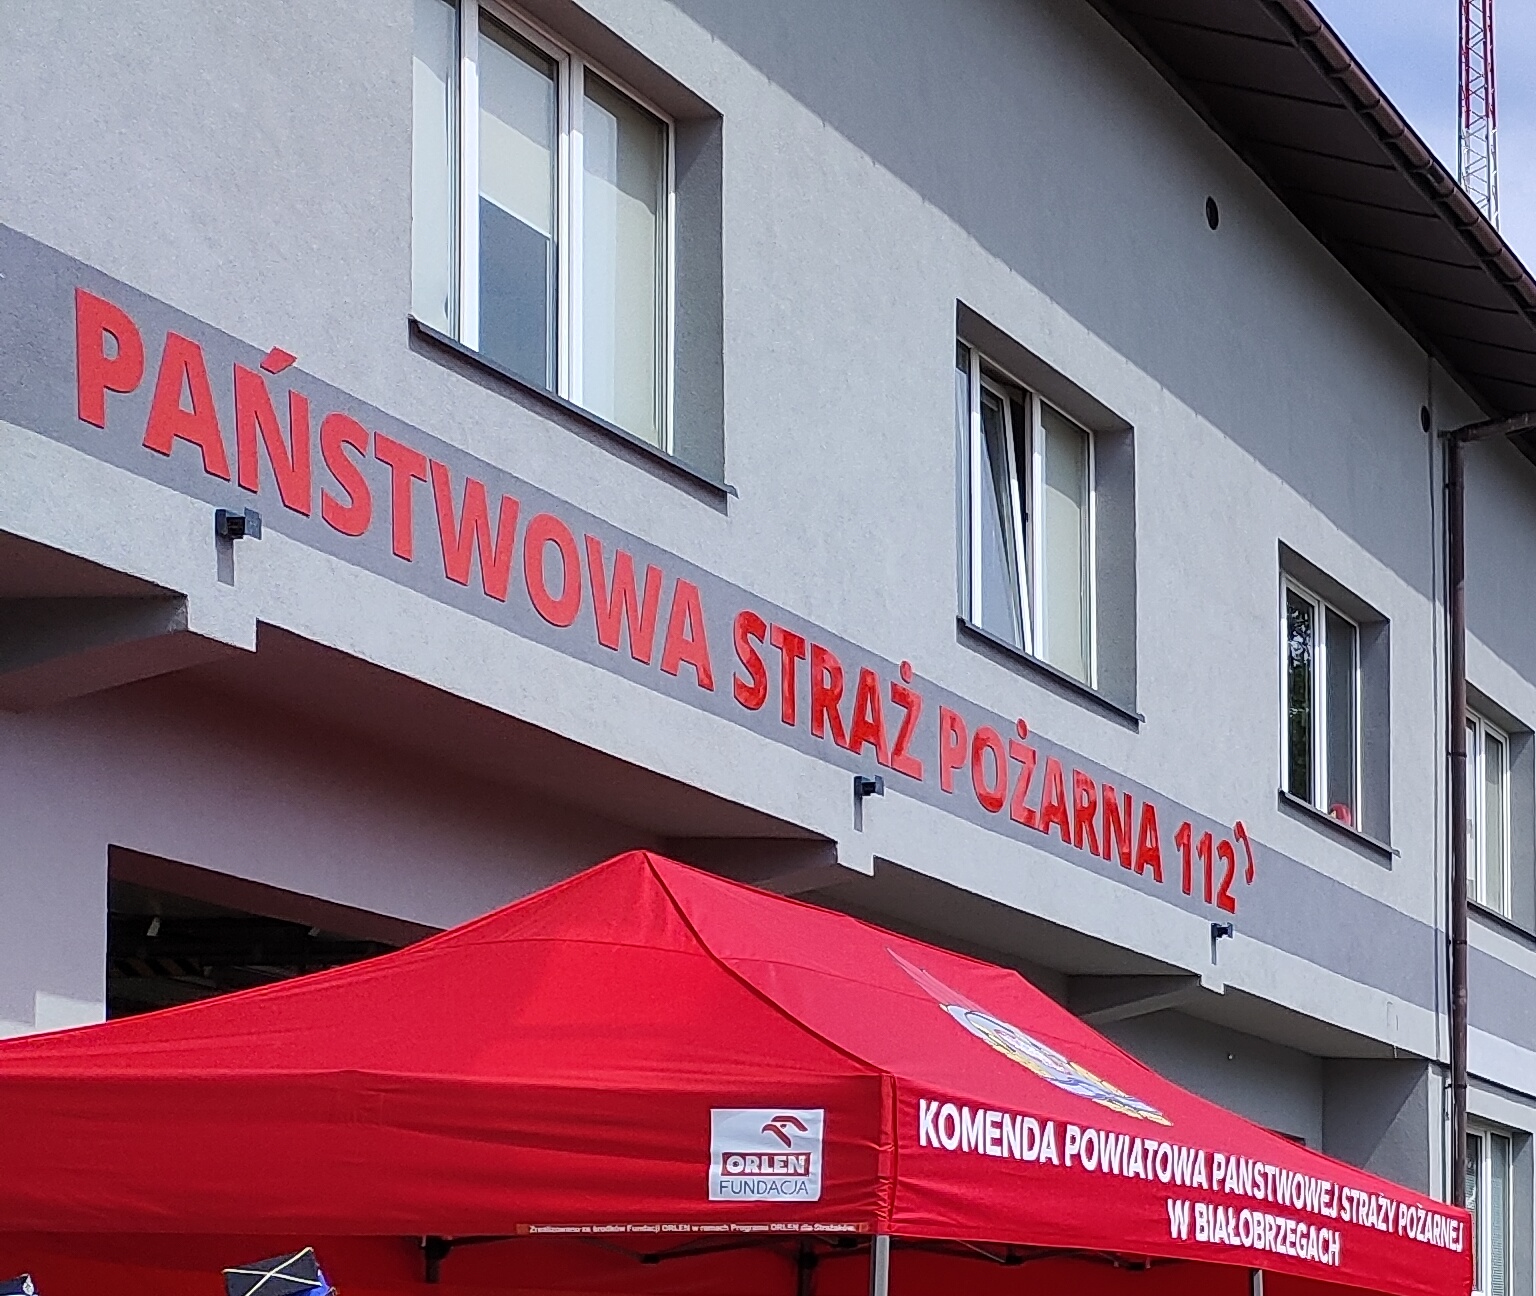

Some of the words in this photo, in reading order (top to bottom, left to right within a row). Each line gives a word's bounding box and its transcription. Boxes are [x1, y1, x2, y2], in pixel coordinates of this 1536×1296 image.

[75, 286, 714, 692] PAŃSTWOWA
[733, 610, 923, 782] STRAŻ
[939, 704, 1163, 883] POŻARNA
[1175, 821, 1236, 914] 112
[719, 1180, 809, 1195] FUNDACJA
[726, 1155, 807, 1174] ORLEN
[919, 1098, 1059, 1166] KOMENDA
[1065, 1124, 1208, 1190] POWIATOWA
[1398, 1203, 1464, 1253] POŻARNEJ
[1167, 1198, 1190, 1240] W
[1195, 1202, 1340, 1267] BIAŁOBRZEGACH
